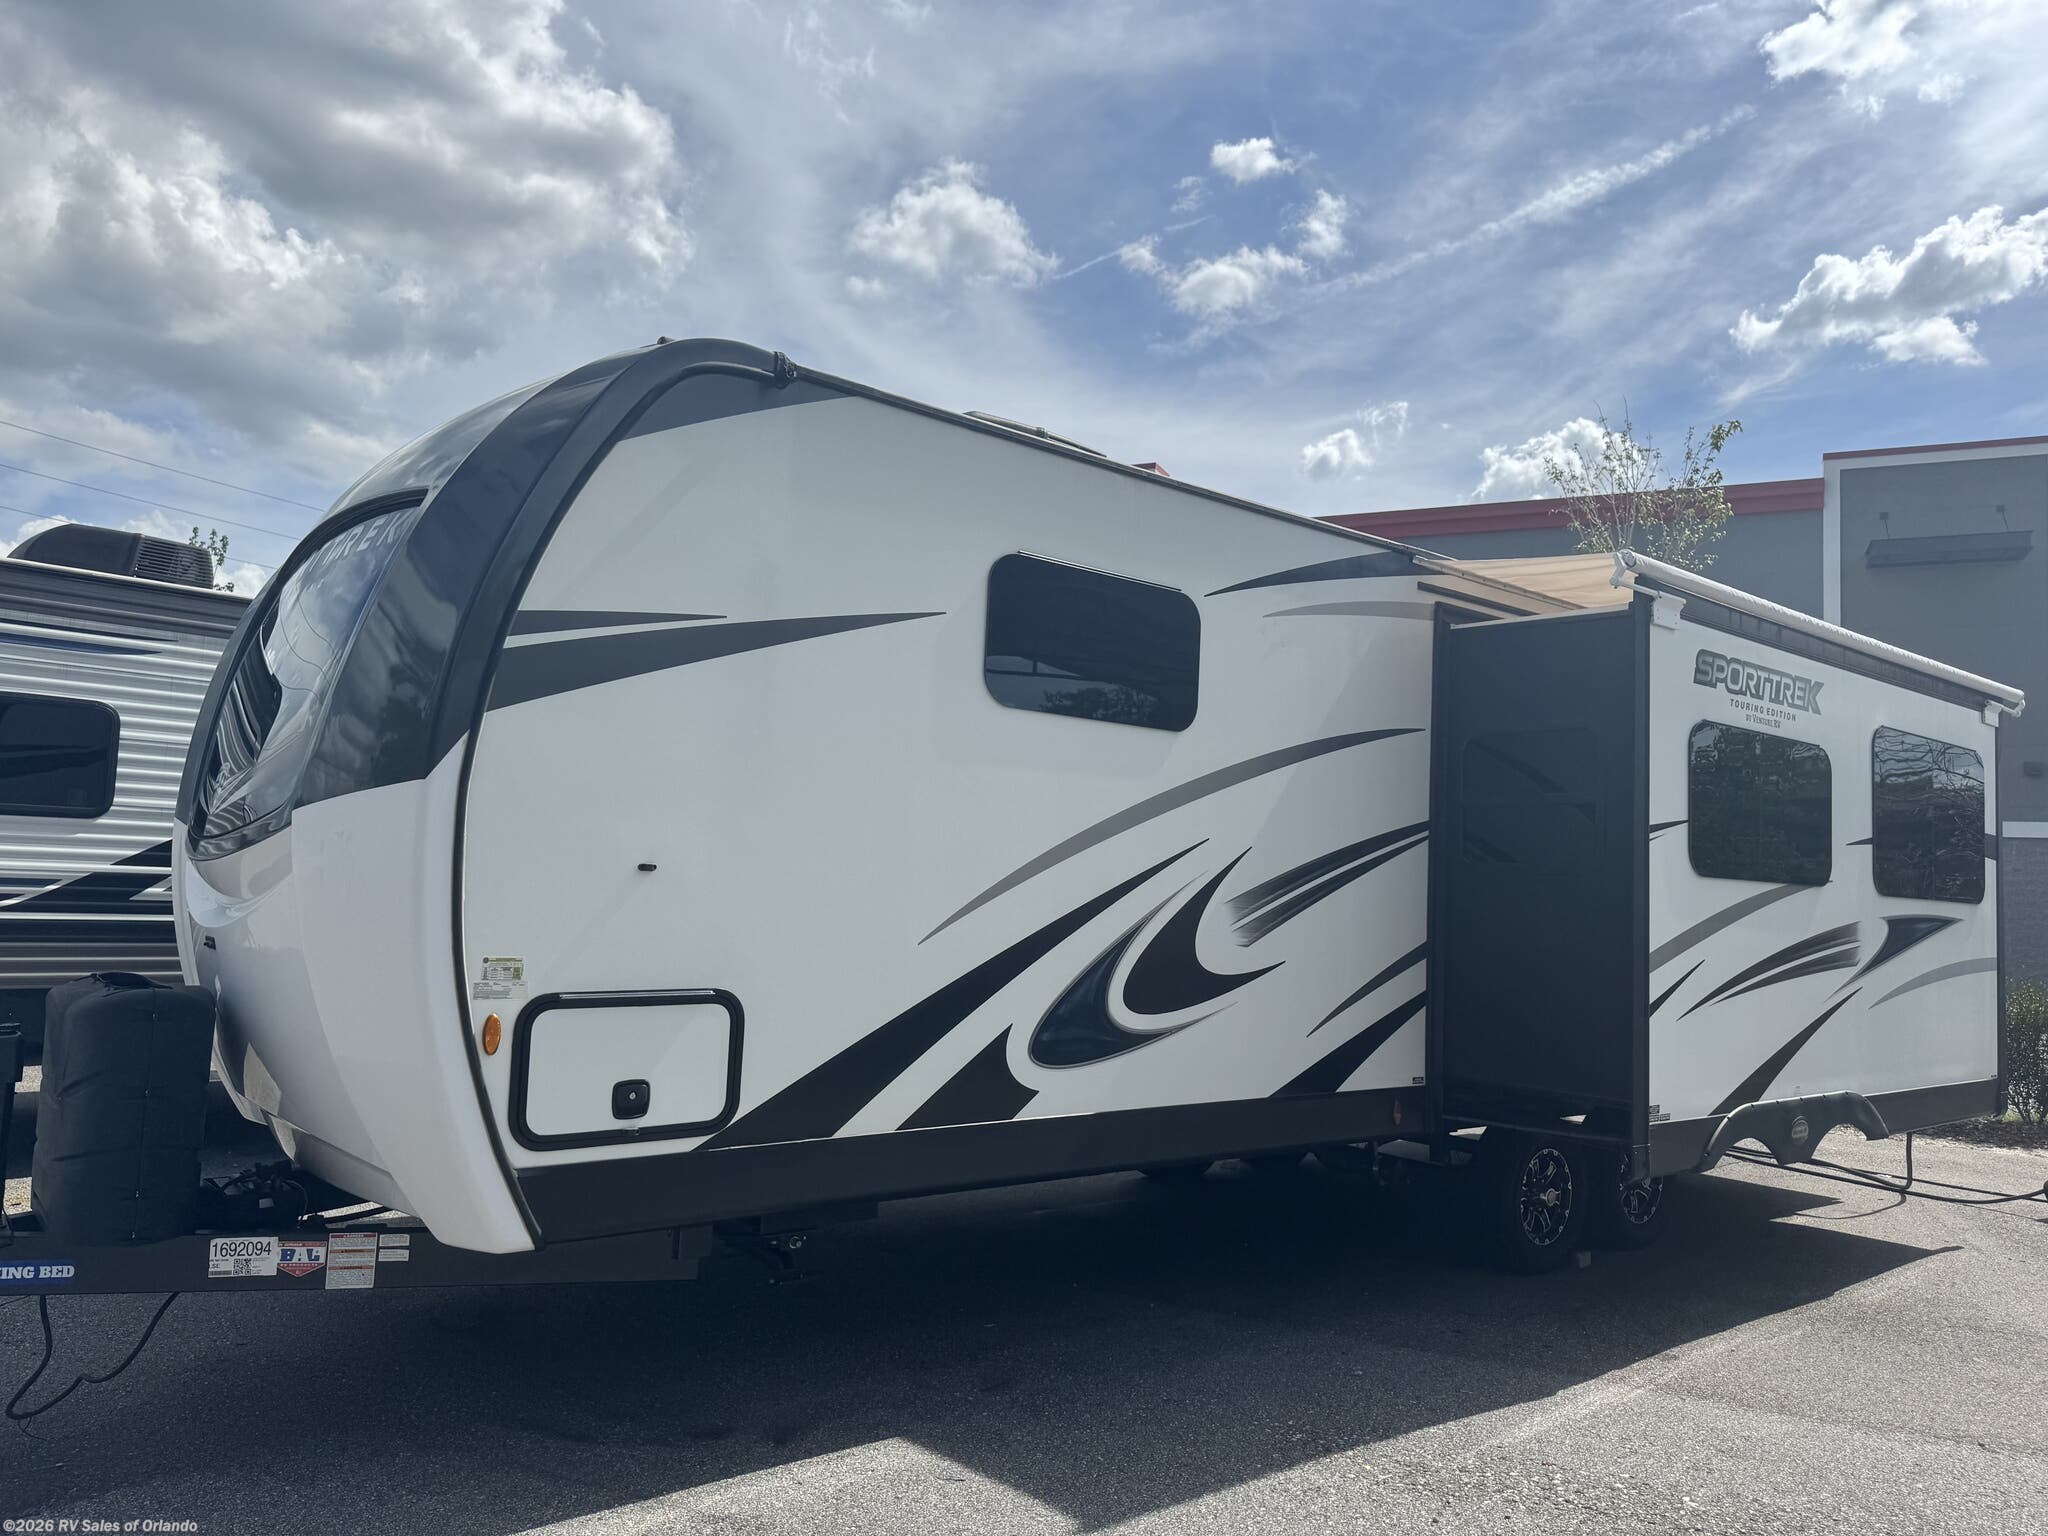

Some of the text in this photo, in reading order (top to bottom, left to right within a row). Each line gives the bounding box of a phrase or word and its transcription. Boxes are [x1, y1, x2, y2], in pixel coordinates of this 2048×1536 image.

[1693, 649, 1824, 715] SPORTTREK
[1730, 698, 1797, 721] TOURING EDITION
[212, 1241, 272, 1258] 1692094
[0, 1265, 75, 1280] ING BED
